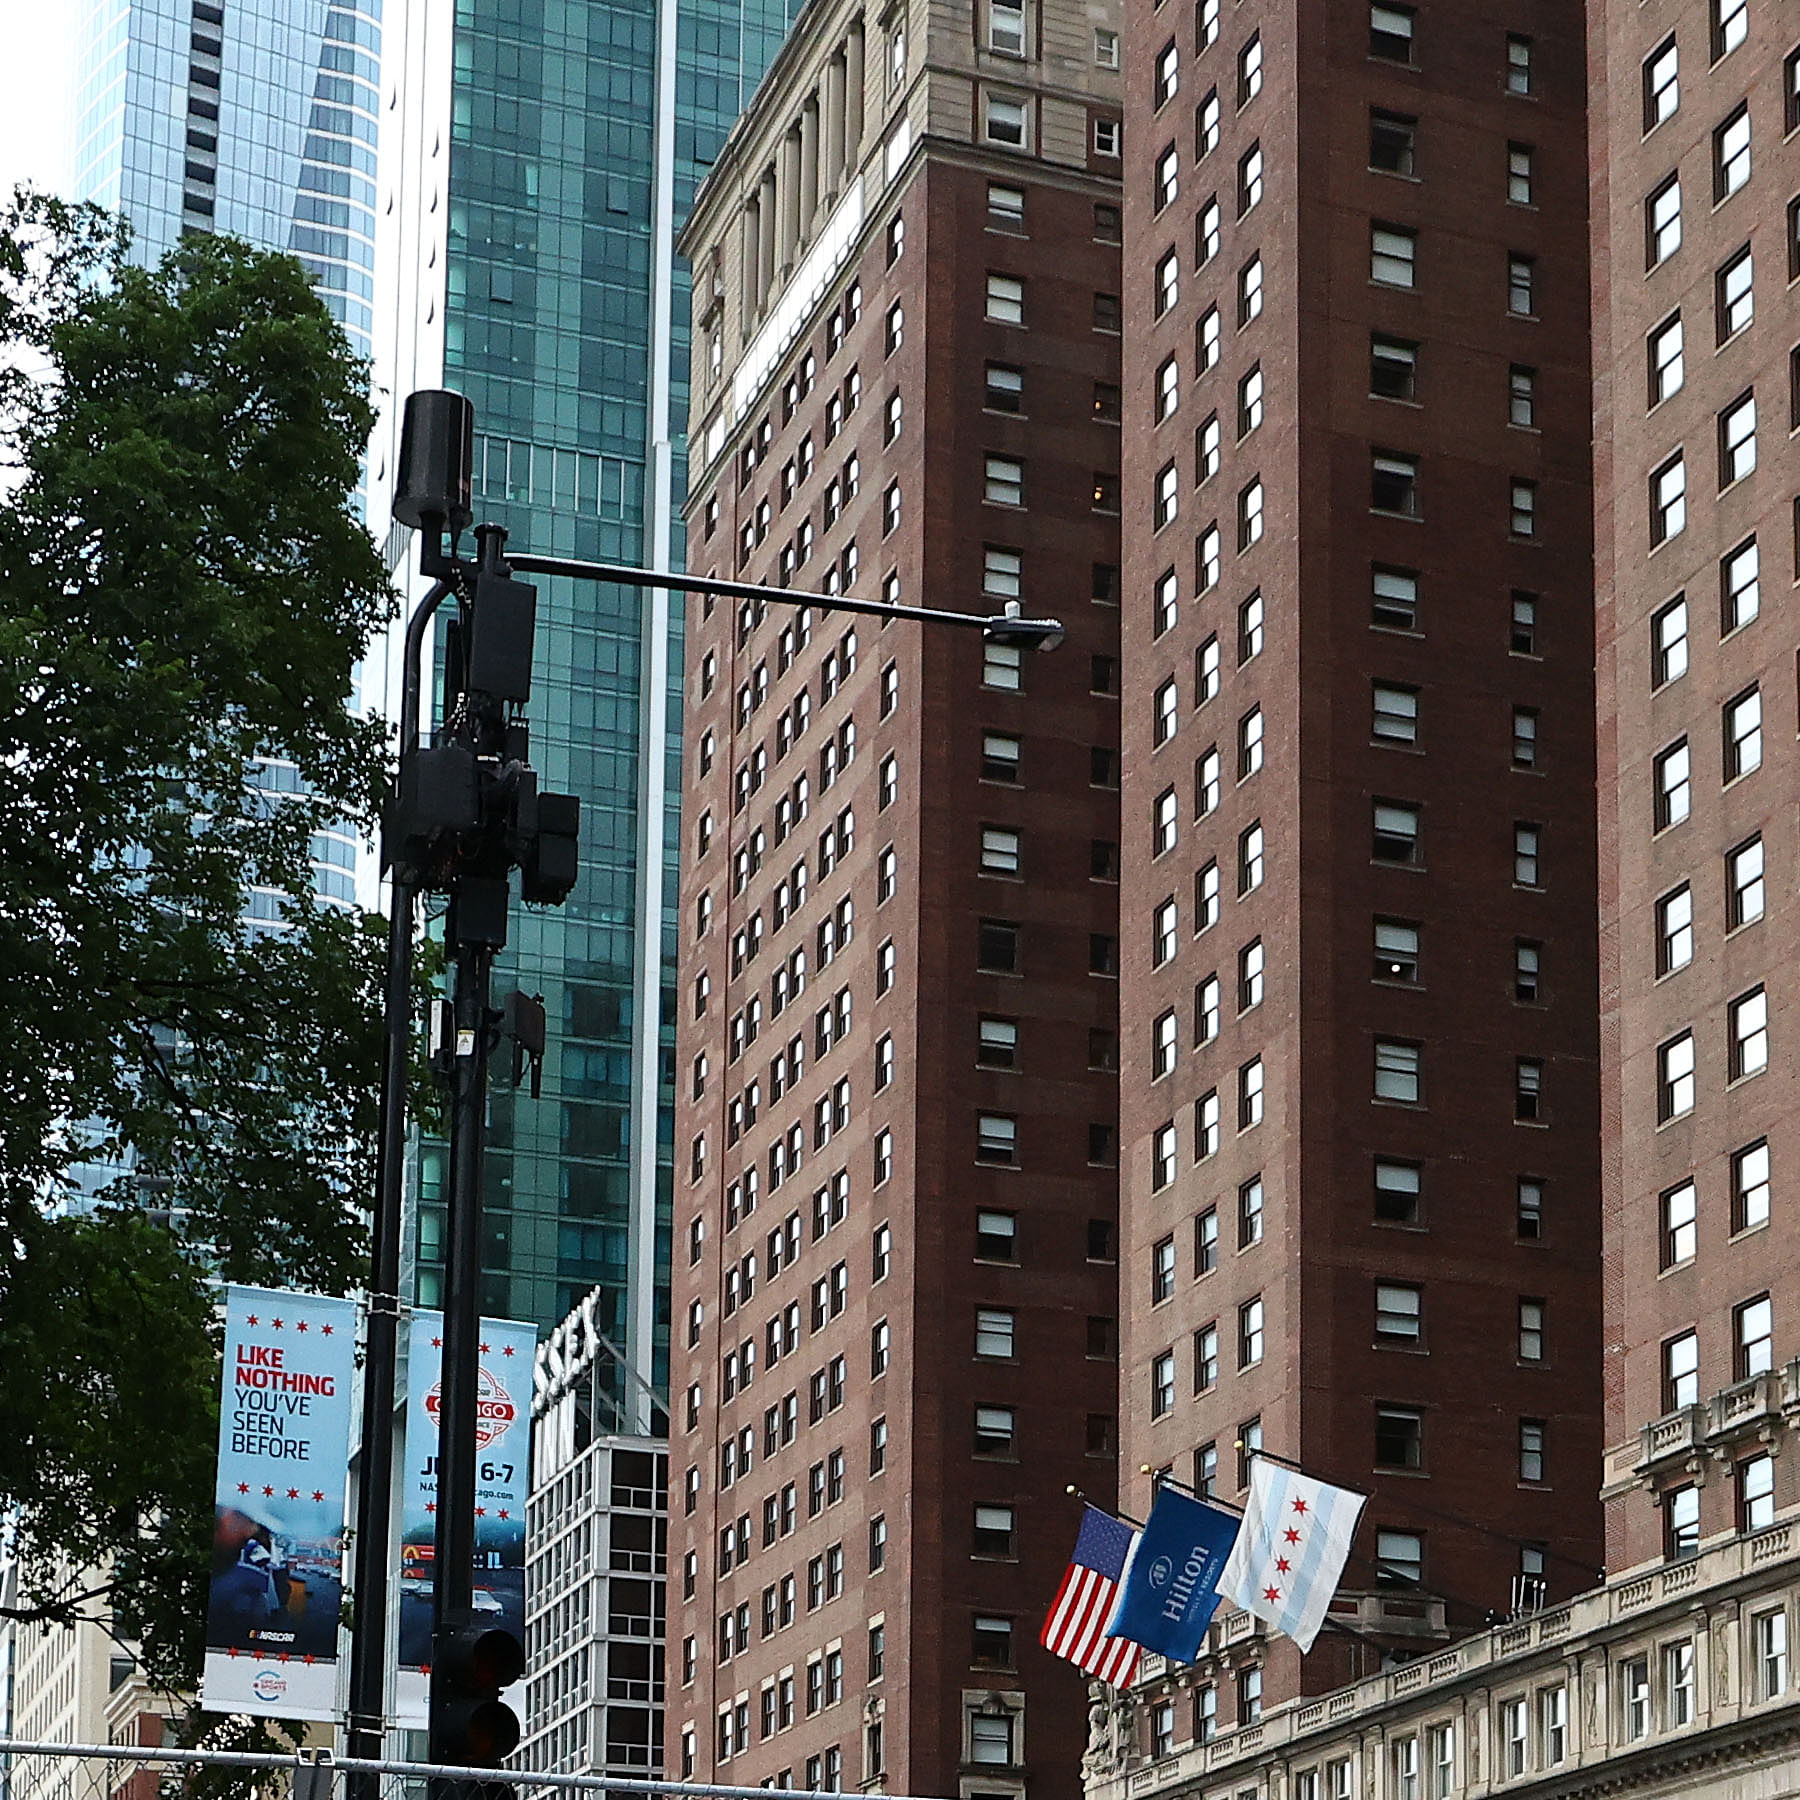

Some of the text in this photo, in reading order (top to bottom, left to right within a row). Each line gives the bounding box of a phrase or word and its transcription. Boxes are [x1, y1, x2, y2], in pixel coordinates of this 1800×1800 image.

[236, 1343, 284, 1368] LIKE
[235, 1366, 335, 1396] NOTHING
[235, 1387, 311, 1416] YOU'VE
[233, 1410, 284, 1436] SEEN
[232, 1432, 310, 1461] BEFORE
[480, 1462, 514, 1483] 6-7
[1162, 1546, 1209, 1622] Hilton
